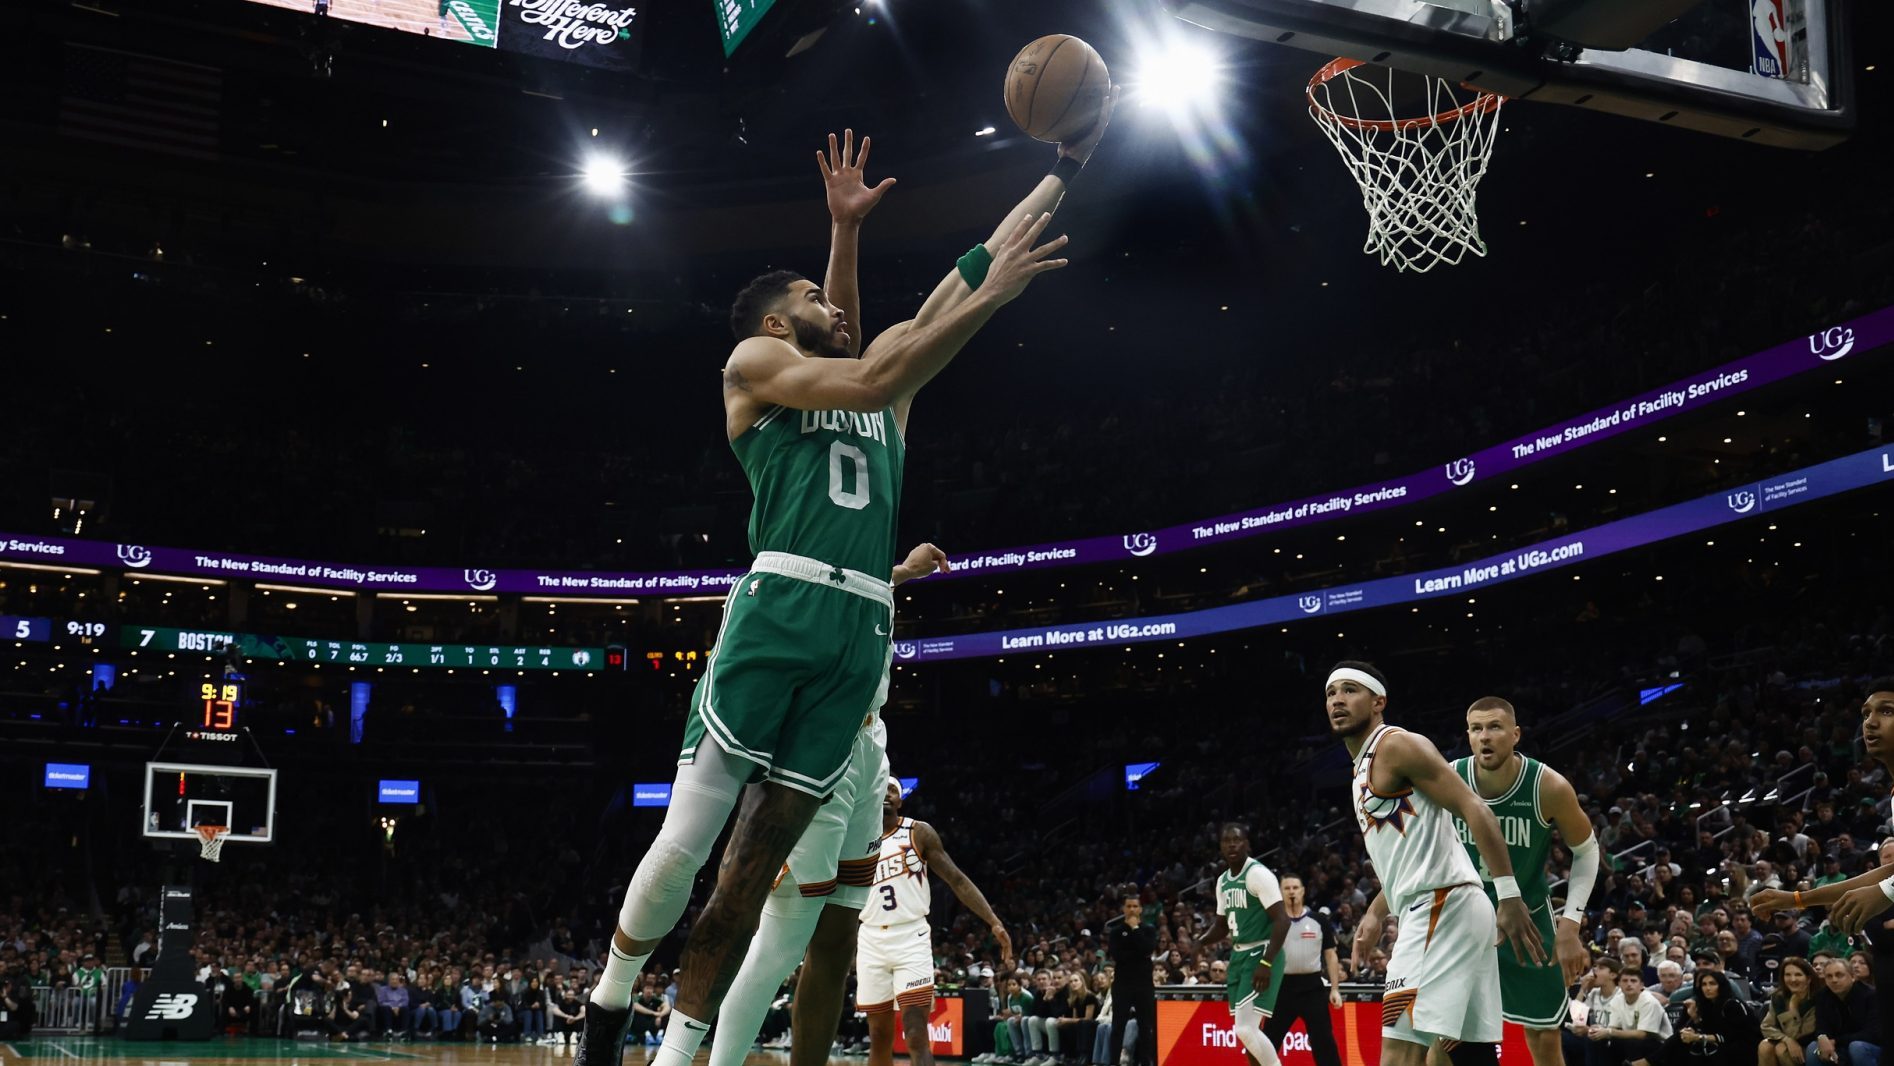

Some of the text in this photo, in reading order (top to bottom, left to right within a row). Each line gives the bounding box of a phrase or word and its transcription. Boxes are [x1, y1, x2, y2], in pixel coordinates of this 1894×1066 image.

[543, 16, 619, 49] Here
[1759, 56, 1776, 74] NBA
[1511, 369, 1748, 459] The New Standard of Facility Services
[829, 439, 869, 510] 0
[1192, 486, 1407, 539] The New Standard of Facility Services
[9, 540, 65, 555] Services
[970, 556, 984, 569] of
[985, 553, 1026, 567] Facility
[1027, 547, 1076, 562] Services
[195, 556, 417, 584] The New Standard of Facility Services
[1415, 541, 1584, 594] Learn More at UG2.com
[537, 573, 737, 589] The New Standard of Facility Servic
[16, 620, 30, 638] 5
[67, 621, 105, 637] 9:19
[139, 629, 156, 647] 7
[1002, 622, 1176, 650] Learn More at UG2.com
[308, 649, 316, 659] 0
[330, 650, 338, 660] 7
[385, 652, 403, 663] 2/3
[430, 654, 444, 664] 1/1
[468, 655, 473, 665] 1
[490, 655, 499, 665] 0
[517, 656, 524, 666] 2
[541, 656, 549, 666] 4
[201, 683, 238, 702] 9:19
[205, 699, 233, 728] 13
[200, 731, 238, 742] TISSOT
[1456, 815, 1531, 848] BOON
[879, 884, 898, 912] 3
[1227, 910, 1239, 937] 4
[927, 1020, 952, 1043] habi
[1202, 1023, 1237, 1048] Find
[1283, 1031, 1313, 1056] pac
